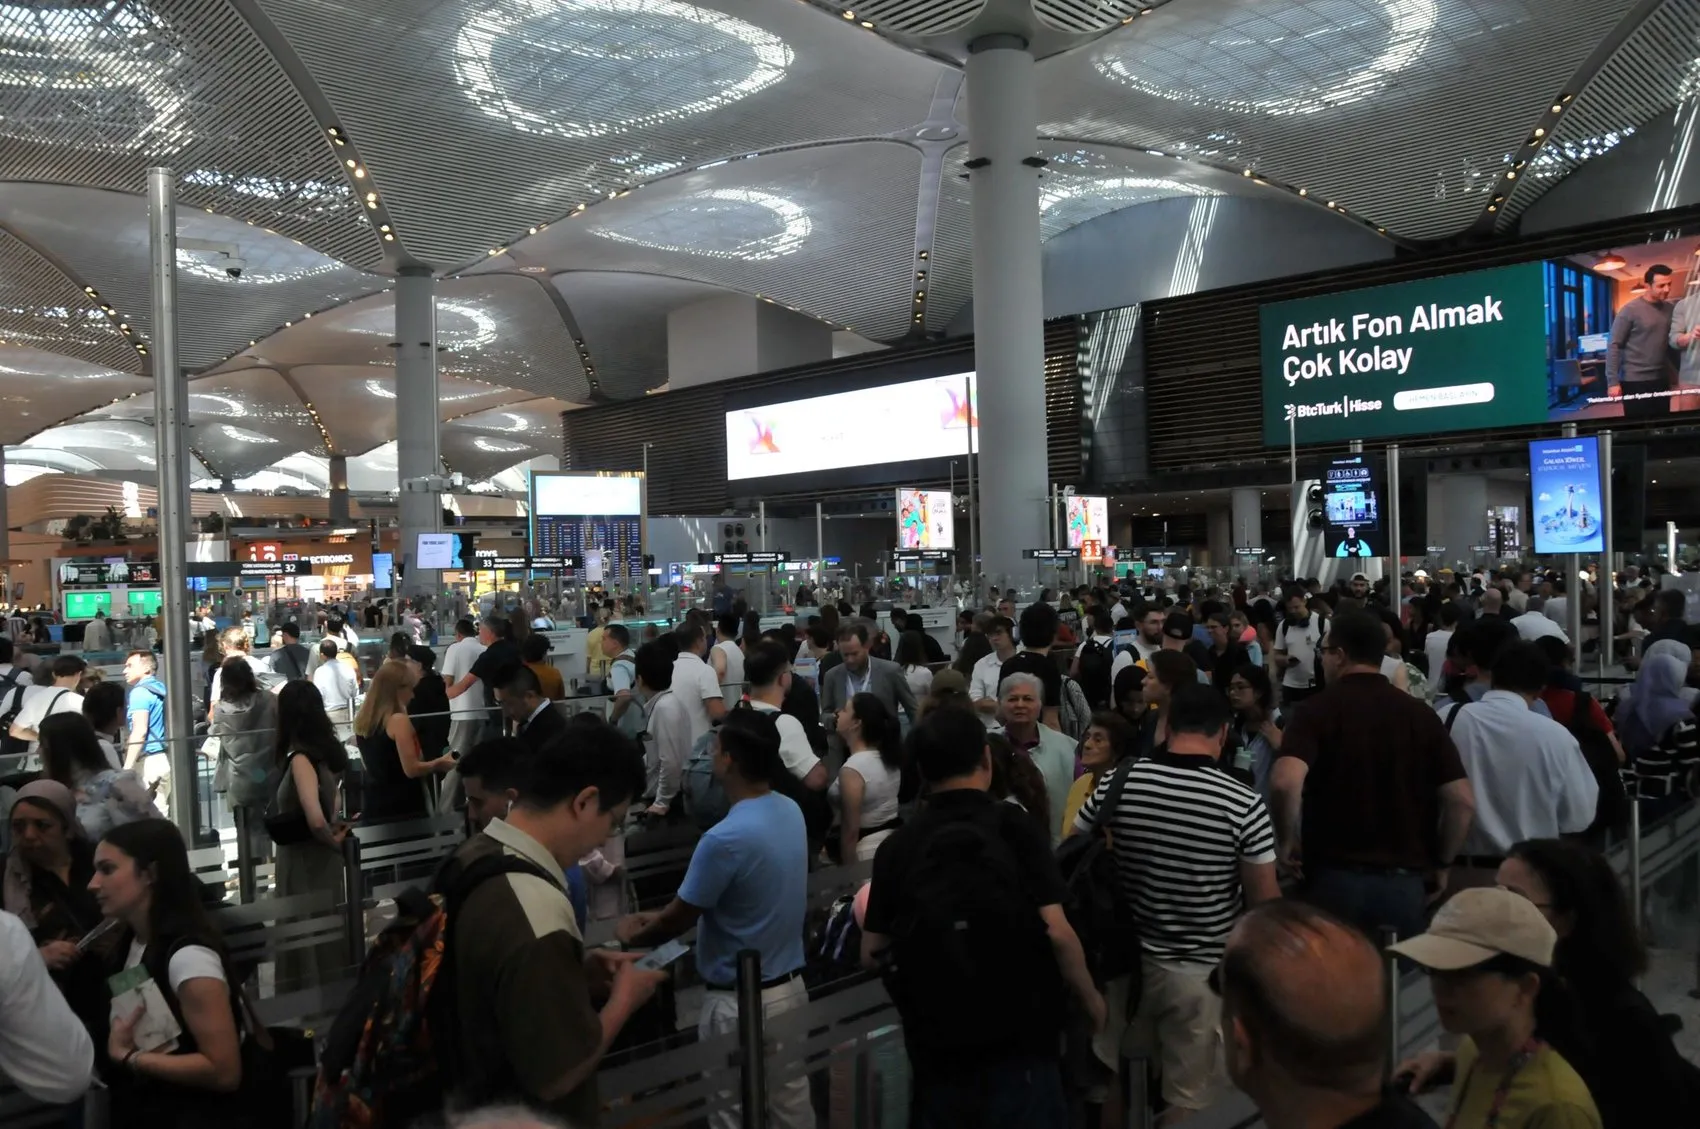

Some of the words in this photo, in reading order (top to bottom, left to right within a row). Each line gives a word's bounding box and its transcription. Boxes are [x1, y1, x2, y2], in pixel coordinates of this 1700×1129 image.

[1282, 318, 1346, 350] Artık
[1352, 313, 1402, 341] Fon
[1409, 295, 1503, 333] Almak
[1283, 352, 1333, 387] Çok
[1339, 345, 1413, 375] Kolay
[1297, 401, 1343, 418] BtcTurk
[1349, 397, 1383, 413] Hisse
[483, 559, 493, 567] 33
[564, 559, 573, 567] 34
[714, 555, 722, 563] 35
[285, 563, 296, 573] 32
